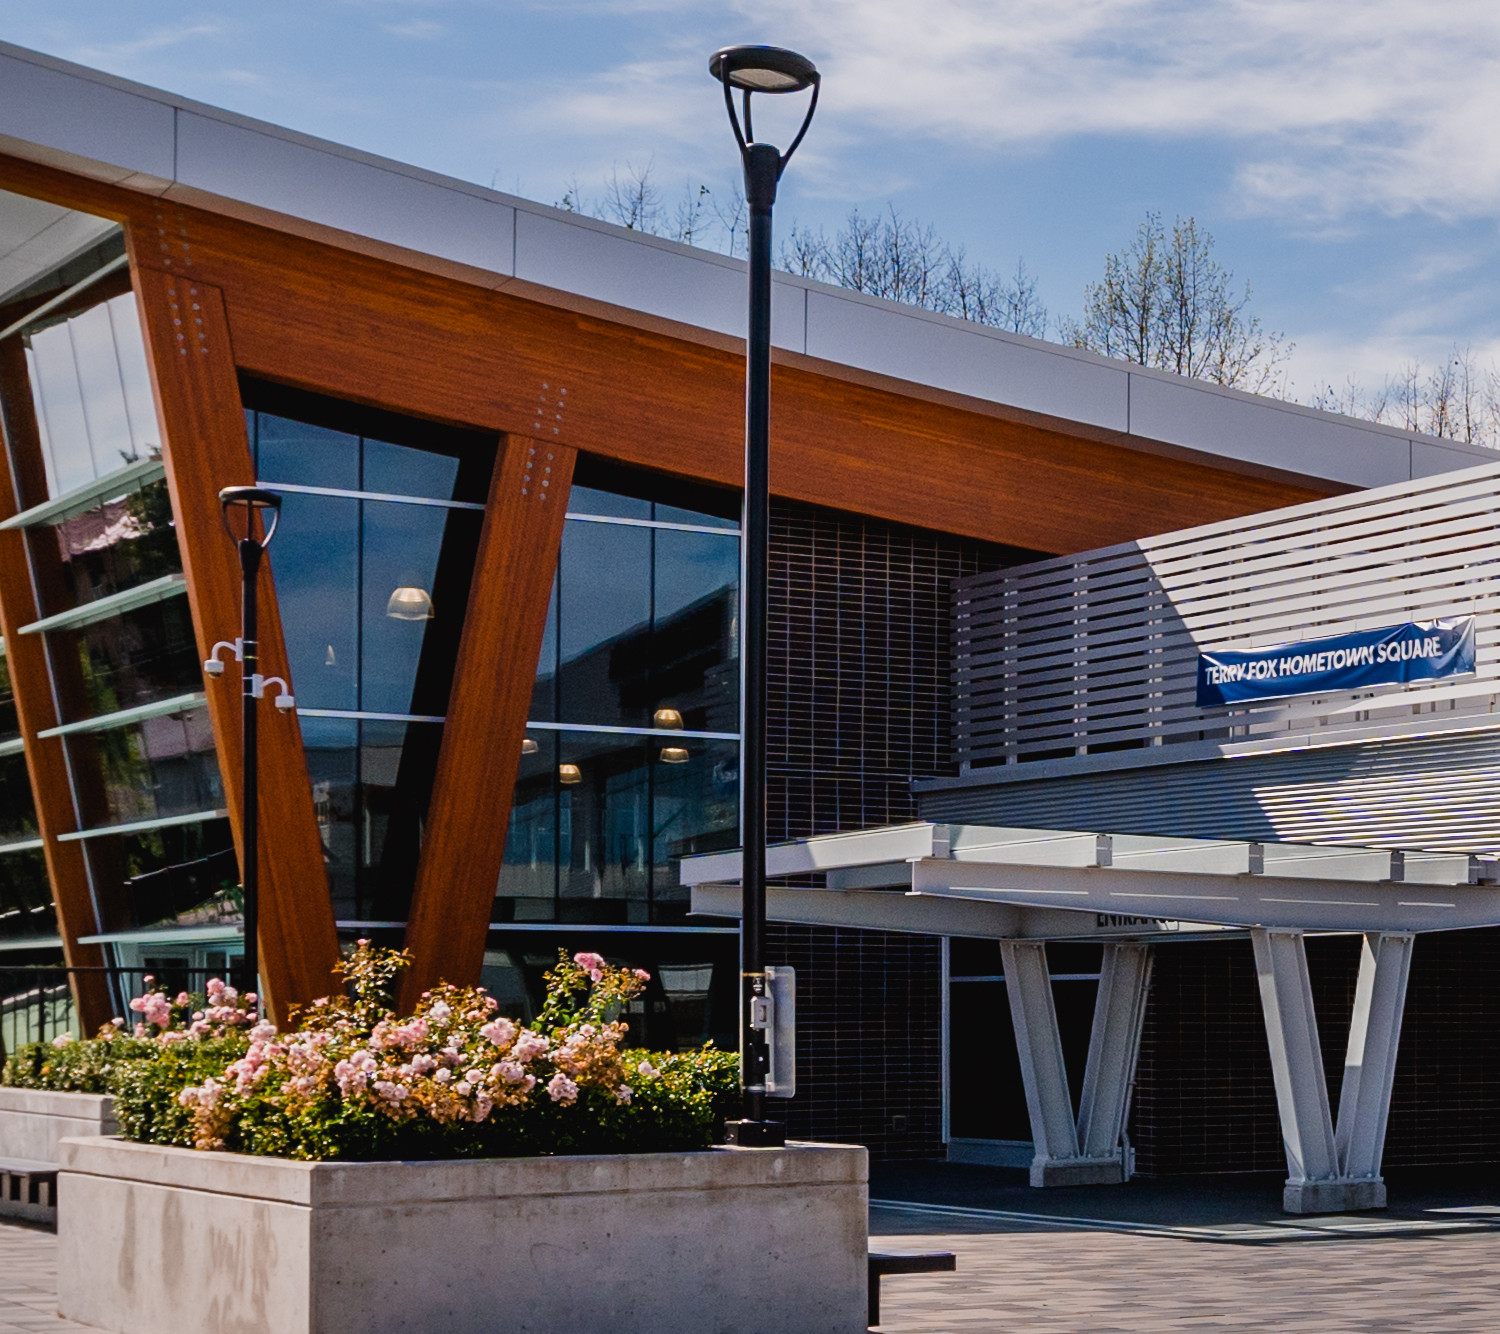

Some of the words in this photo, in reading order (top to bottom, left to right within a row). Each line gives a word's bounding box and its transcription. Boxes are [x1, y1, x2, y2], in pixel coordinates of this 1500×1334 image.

[1206, 662, 1247, 685] TERRY
[1250, 659, 1277, 680] FOX
[1280, 645, 1374, 676] HOMETOWN
[1377, 636, 1443, 664] SQUARE
